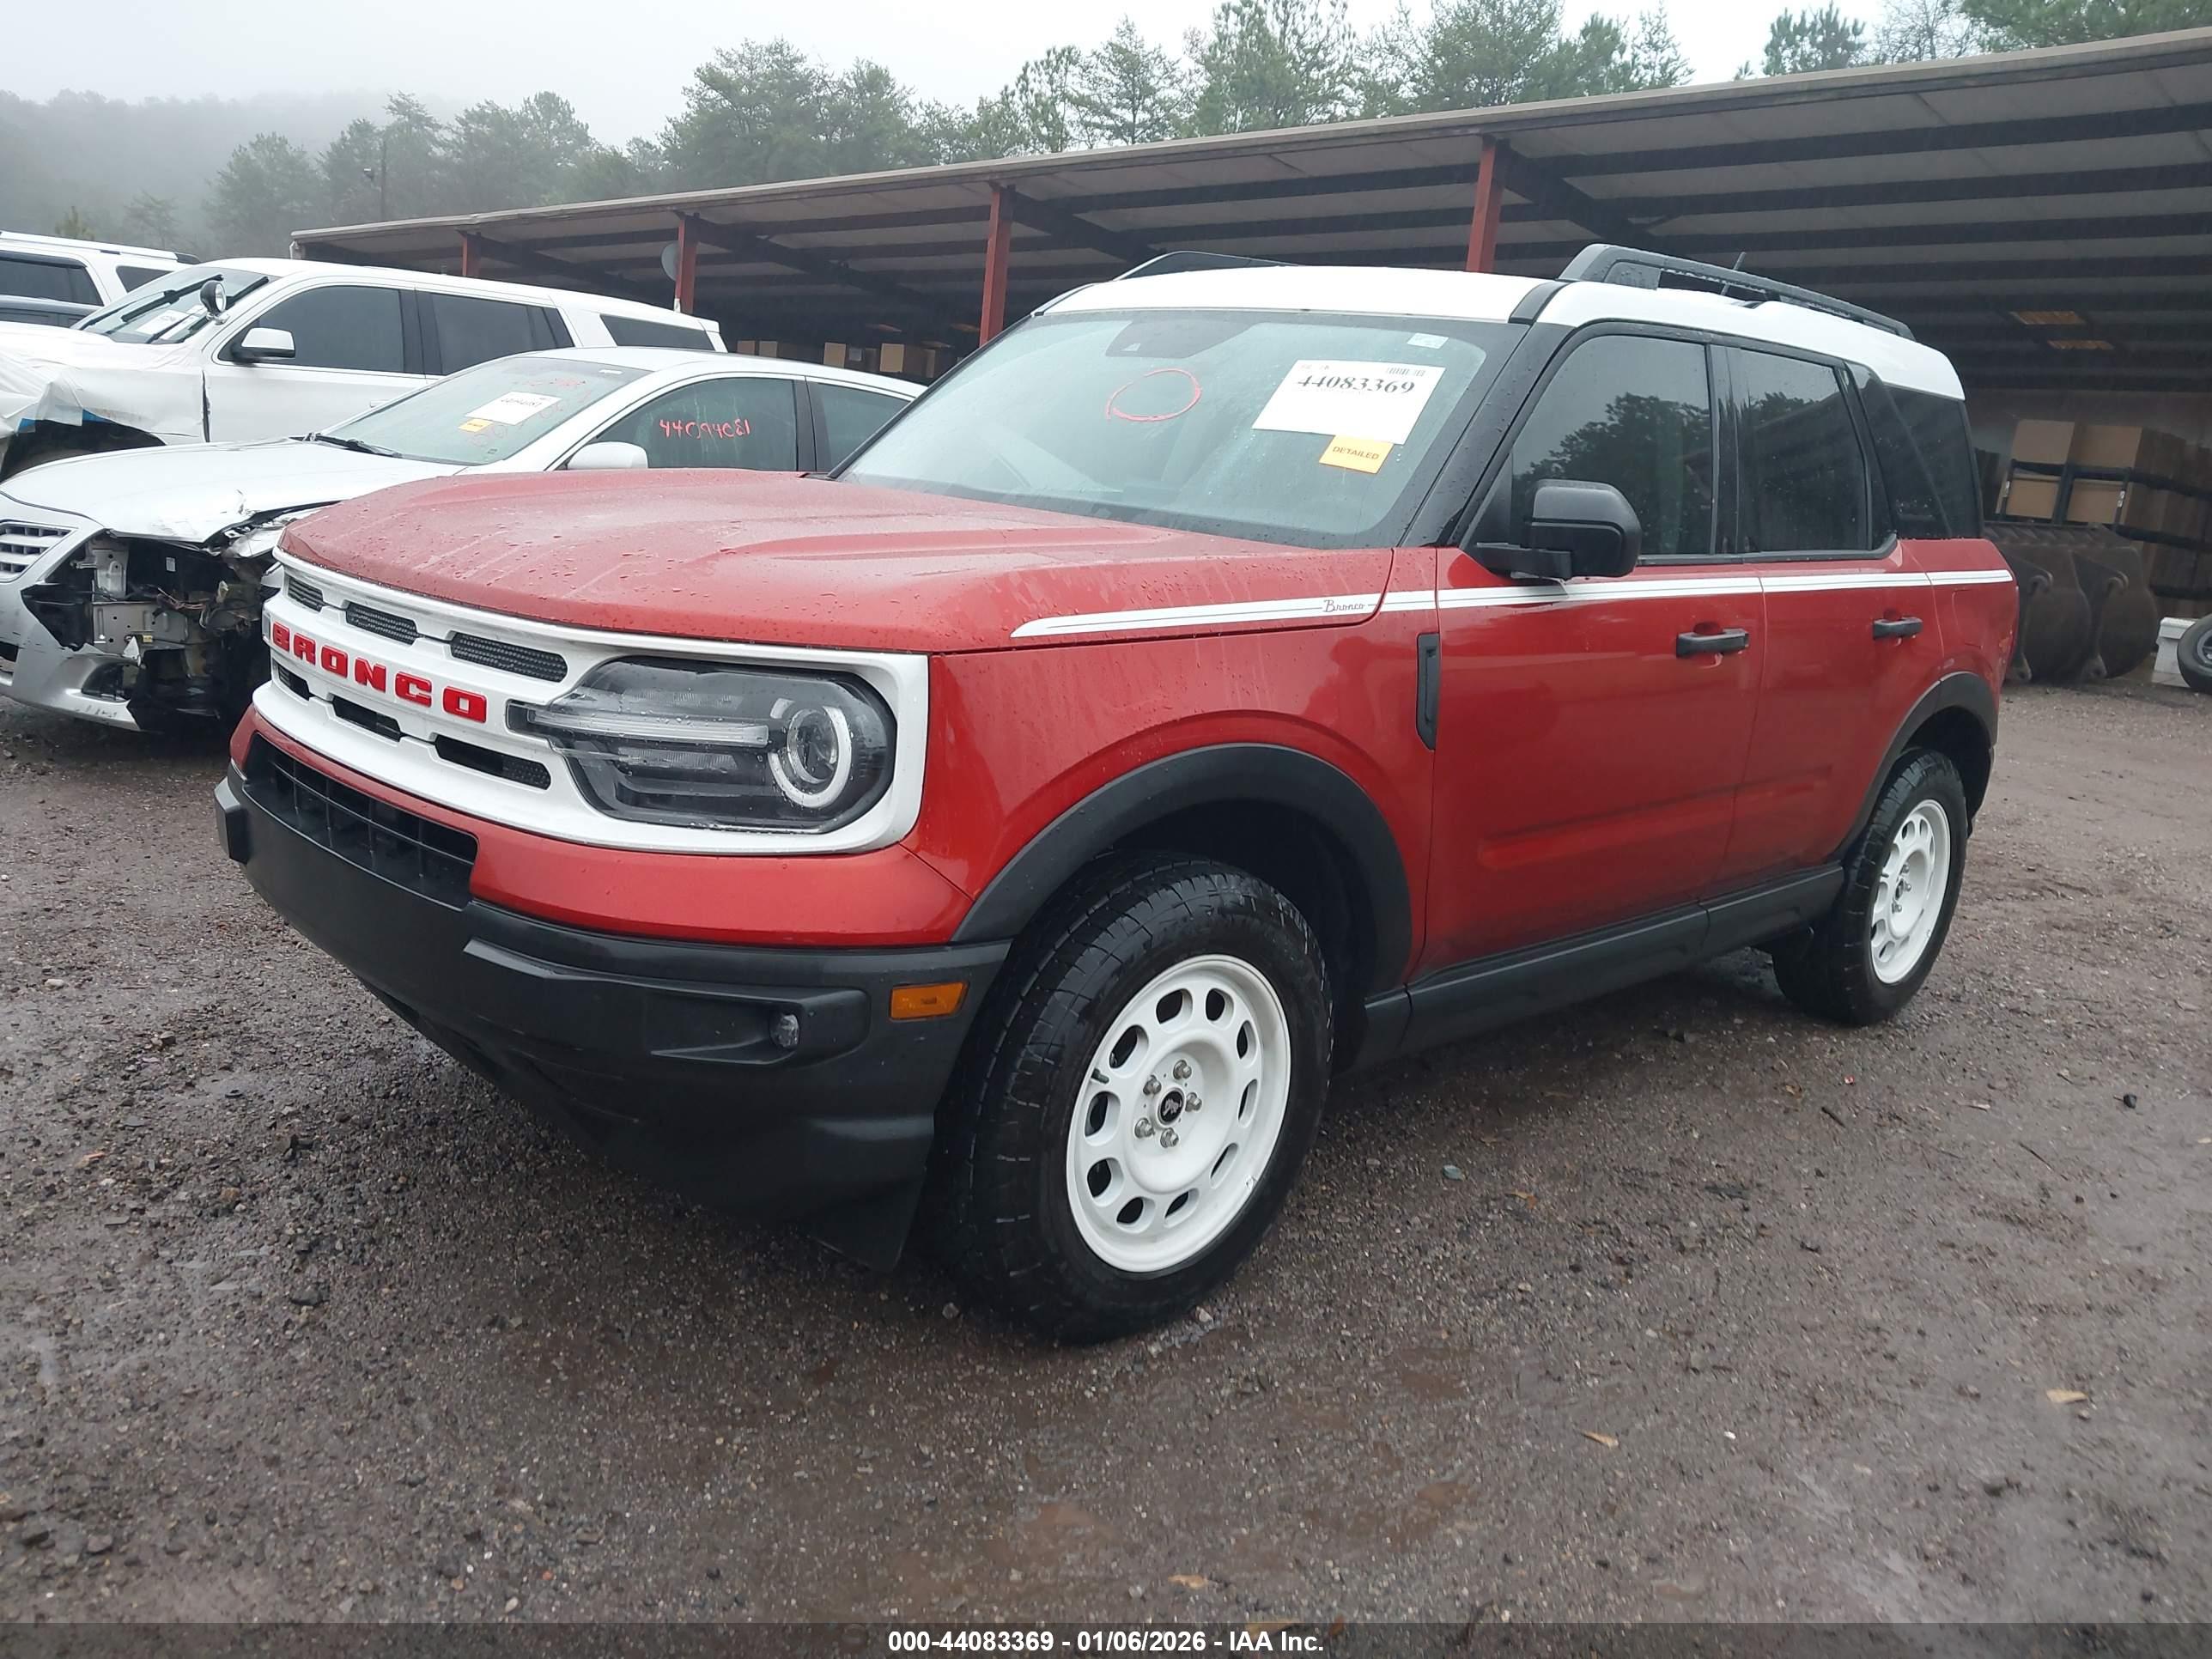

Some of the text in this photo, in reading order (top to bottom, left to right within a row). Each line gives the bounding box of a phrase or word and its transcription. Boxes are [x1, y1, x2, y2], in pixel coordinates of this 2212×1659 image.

[1297, 374, 1415, 393] 44083369
[1332, 446, 1379, 459] DETAILED
[1322, 599, 1364, 612] Bronco
[271, 621, 488, 723] BRONCO
